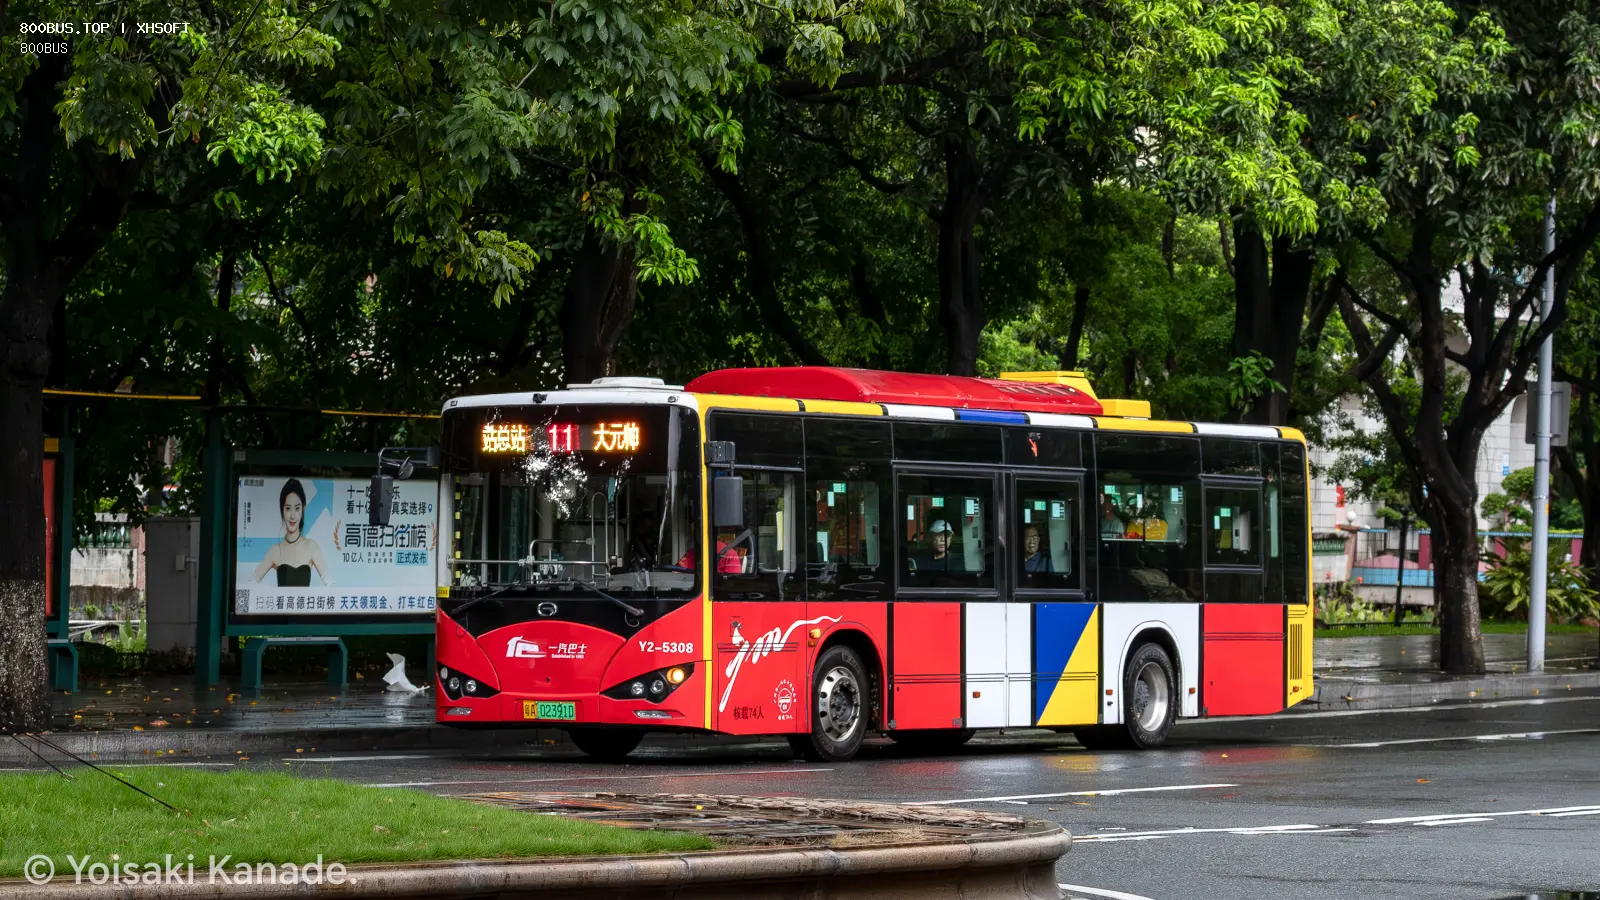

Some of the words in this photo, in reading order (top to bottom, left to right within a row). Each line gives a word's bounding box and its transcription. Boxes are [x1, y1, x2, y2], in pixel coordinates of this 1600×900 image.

[482, 424, 526, 452] 站总站
[549, 424, 572, 452] 11
[593, 423, 640, 451] 大元帅
[346, 500, 427, 515] 看十亿真实选择
[345, 523, 427, 548] 高德扫街榜
[342, 552, 364, 563] 10亿人
[397, 552, 427, 564] 正式发布
[256, 596, 336, 610] 扫码看高德扫街榜
[340, 596, 436, 610] 天天领现金、打车红包
[548, 643, 587, 654] 一汽巴士
[639, 641, 694, 654] Y2-5308
[733, 705, 764, 720] 核载74人
